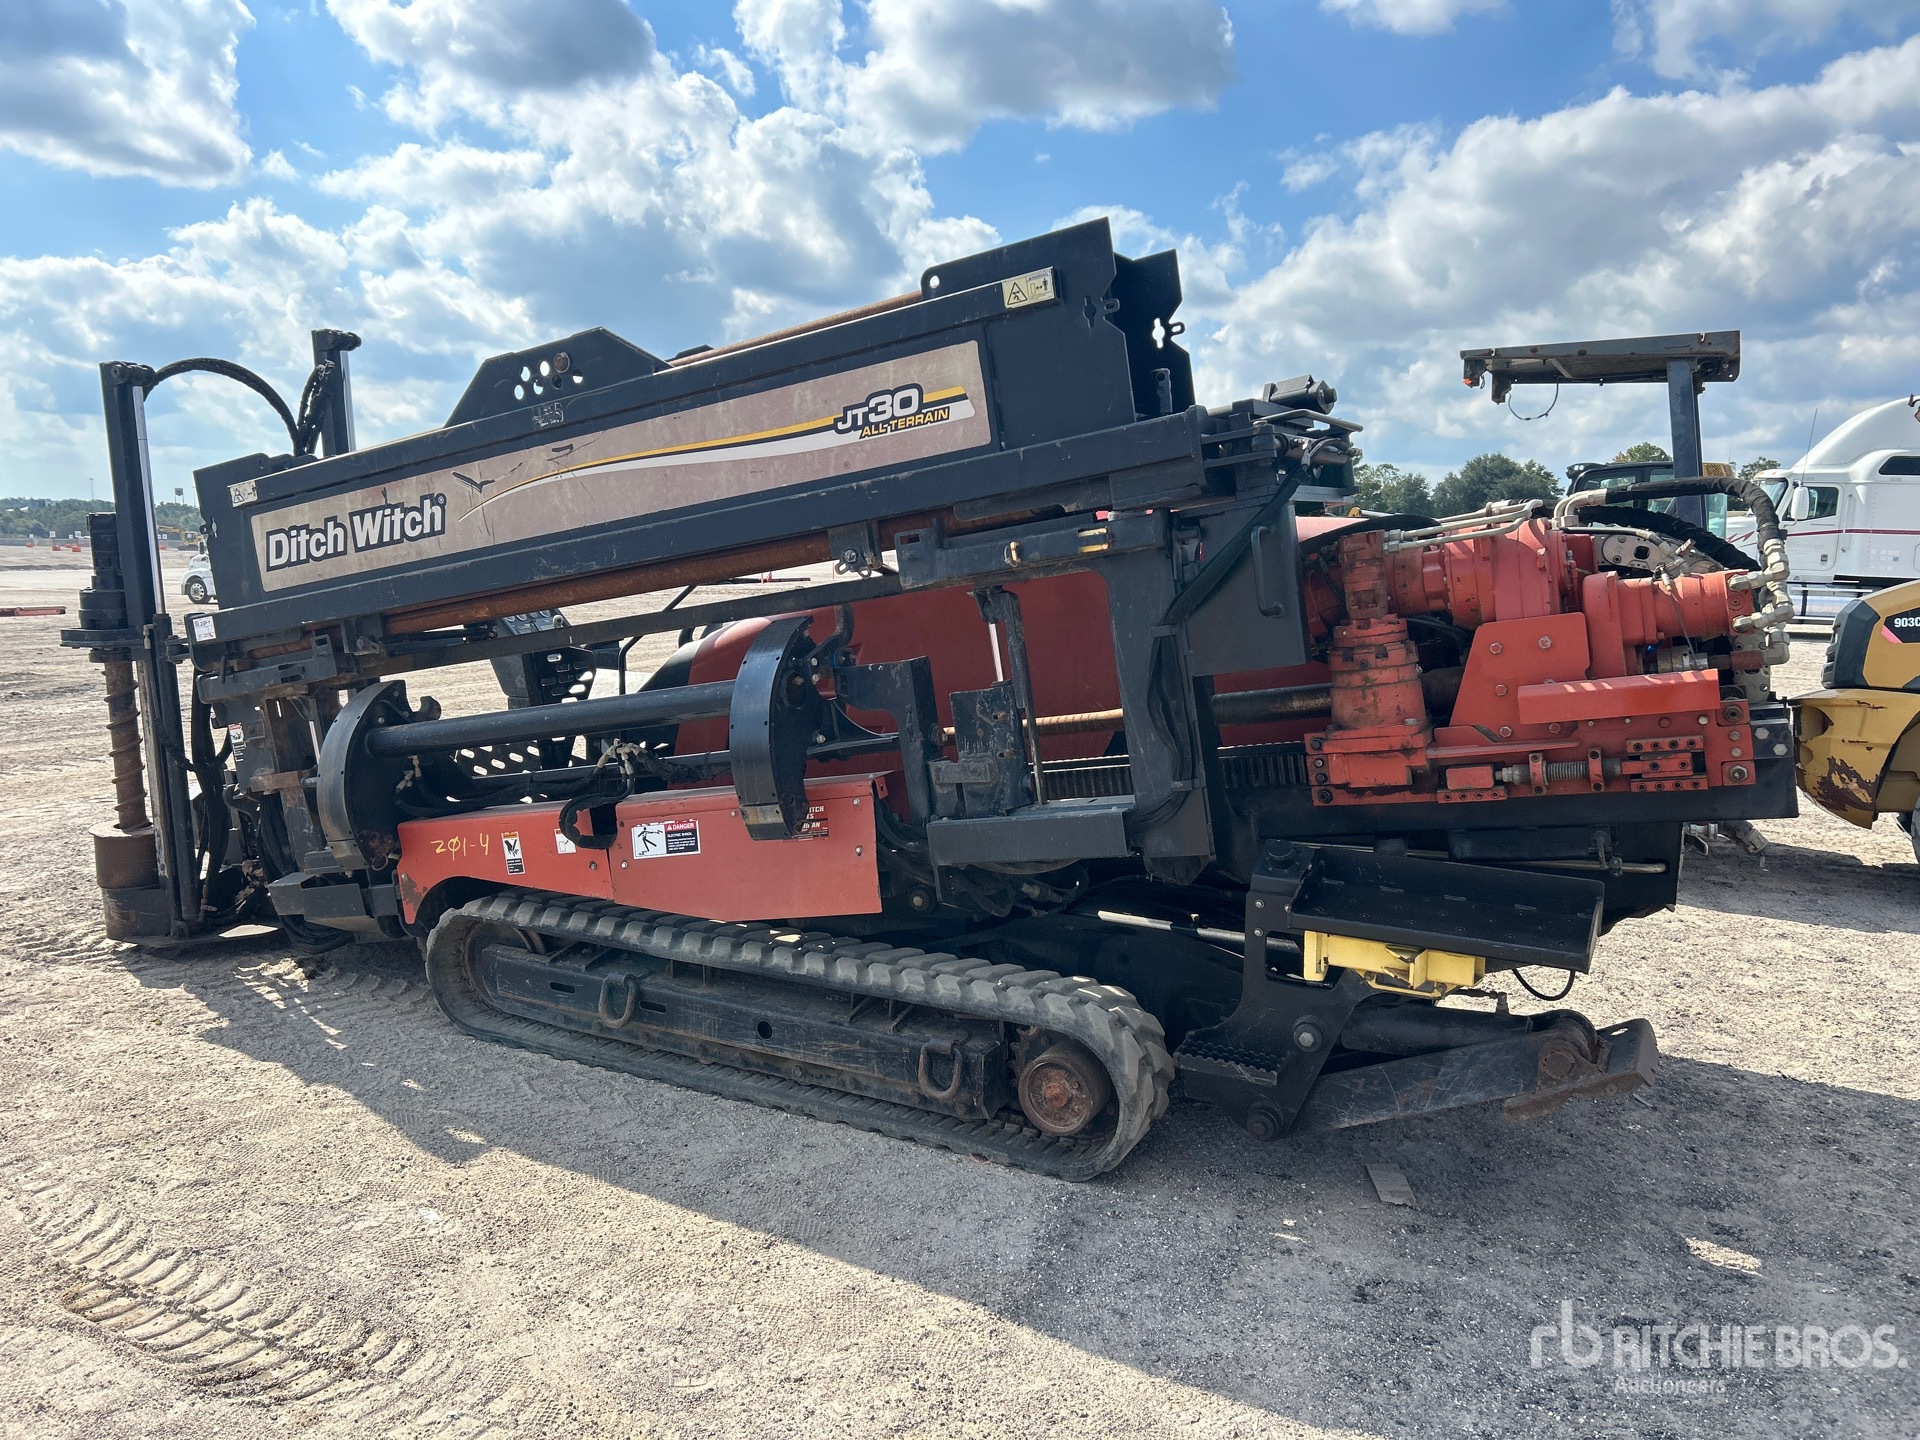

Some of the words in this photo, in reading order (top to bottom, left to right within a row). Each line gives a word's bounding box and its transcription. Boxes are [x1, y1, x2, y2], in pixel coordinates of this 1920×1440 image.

[837, 388, 919, 430] JT30
[889, 408, 949, 430] TERRAIN
[269, 521, 345, 567] Ditch
[352, 498, 442, 548] Witch
